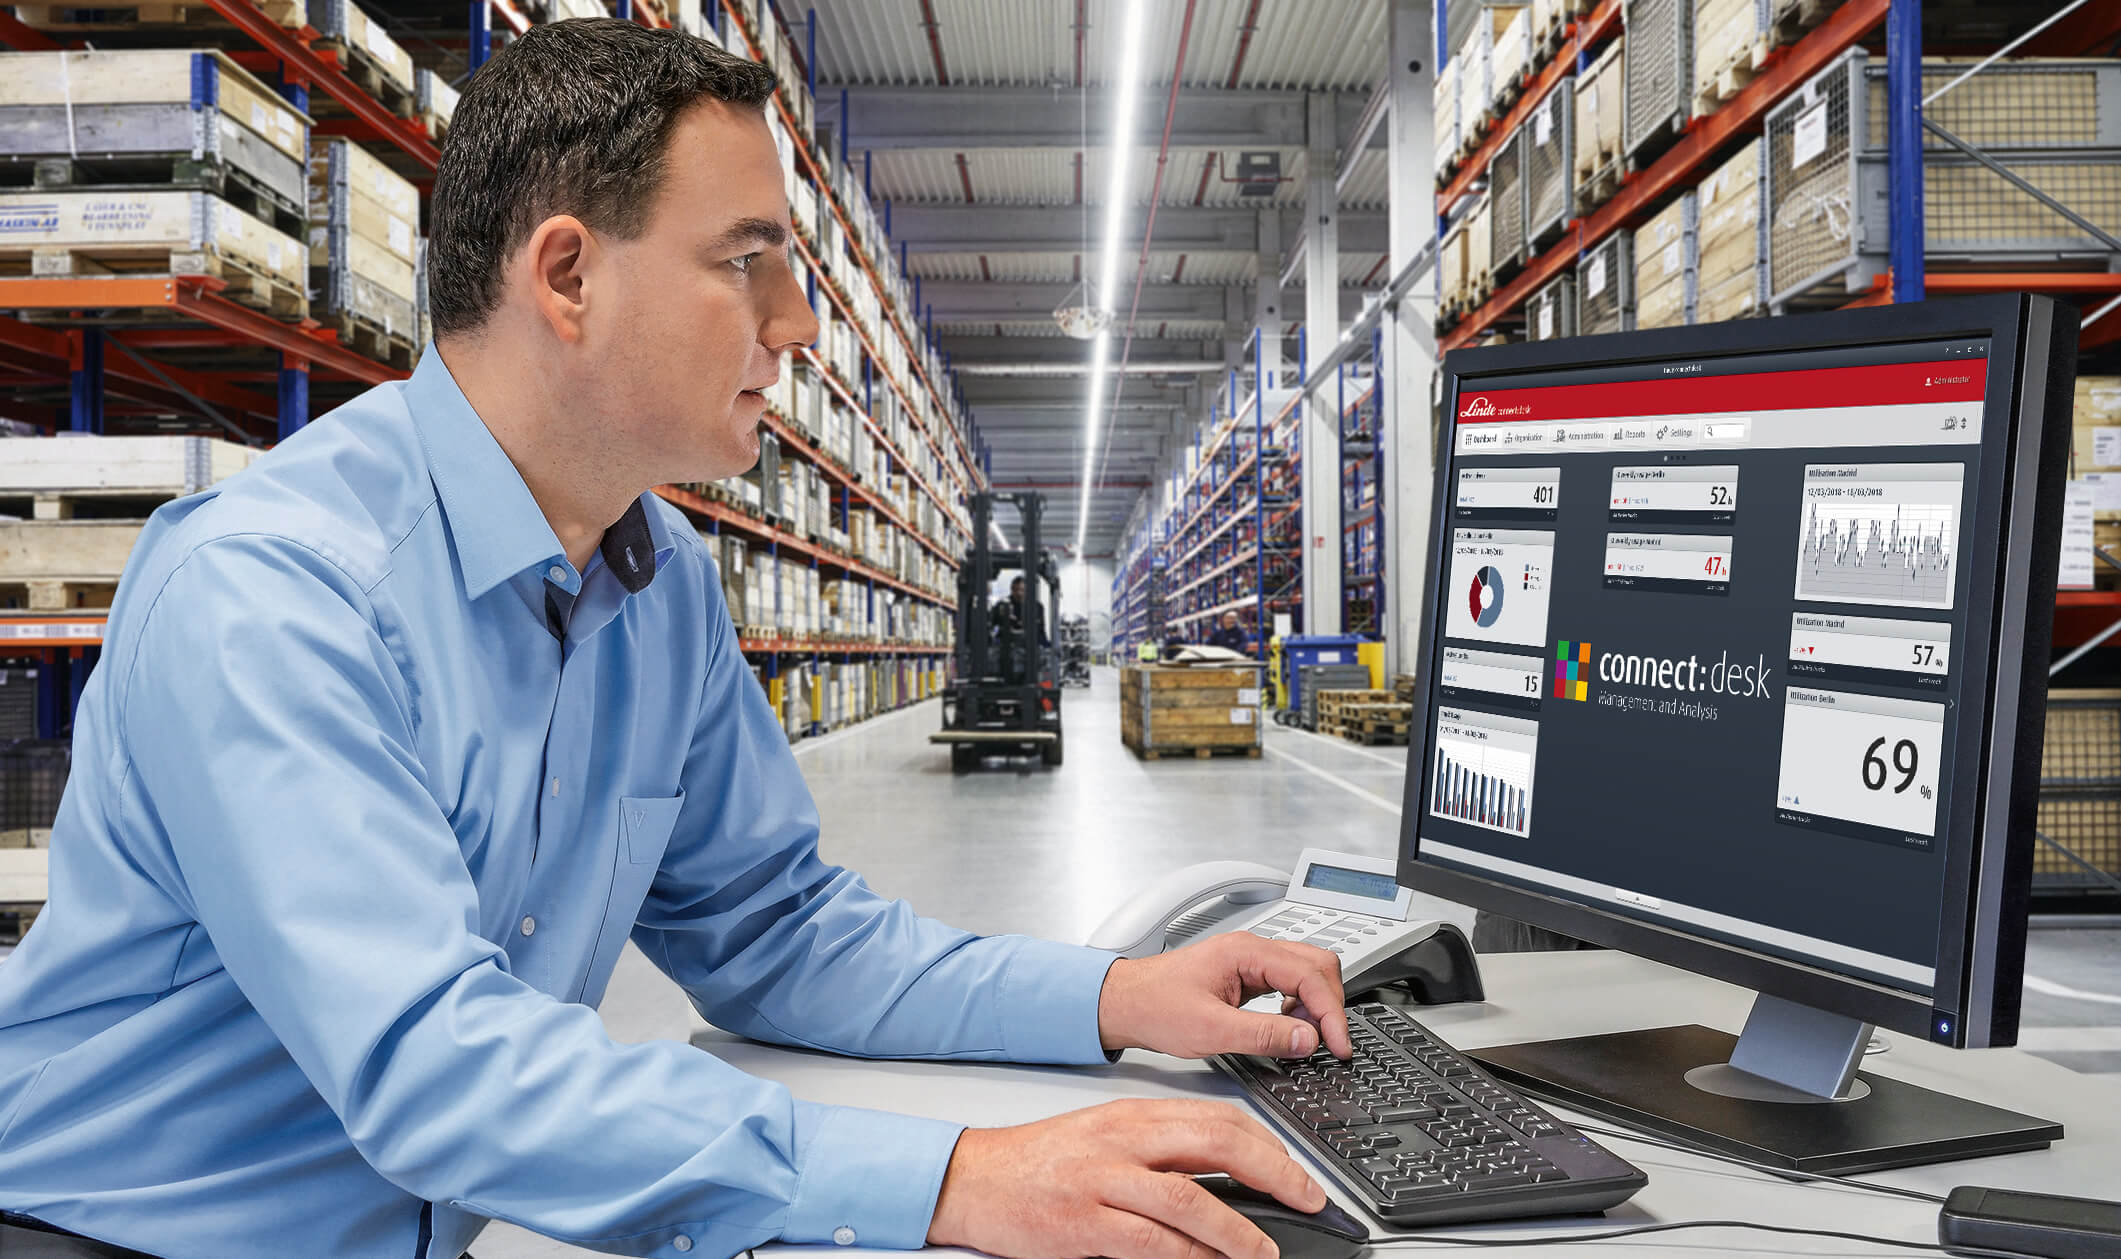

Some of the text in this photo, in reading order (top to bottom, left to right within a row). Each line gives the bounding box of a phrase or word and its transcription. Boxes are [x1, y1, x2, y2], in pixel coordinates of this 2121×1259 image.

[1460, 396, 1497, 418] Linde
[1670, 427, 1694, 439] Settings
[1533, 486, 1554, 503] 401
[1525, 675, 1538, 693] 15
[1598, 690, 1718, 721] Management and Analysis
